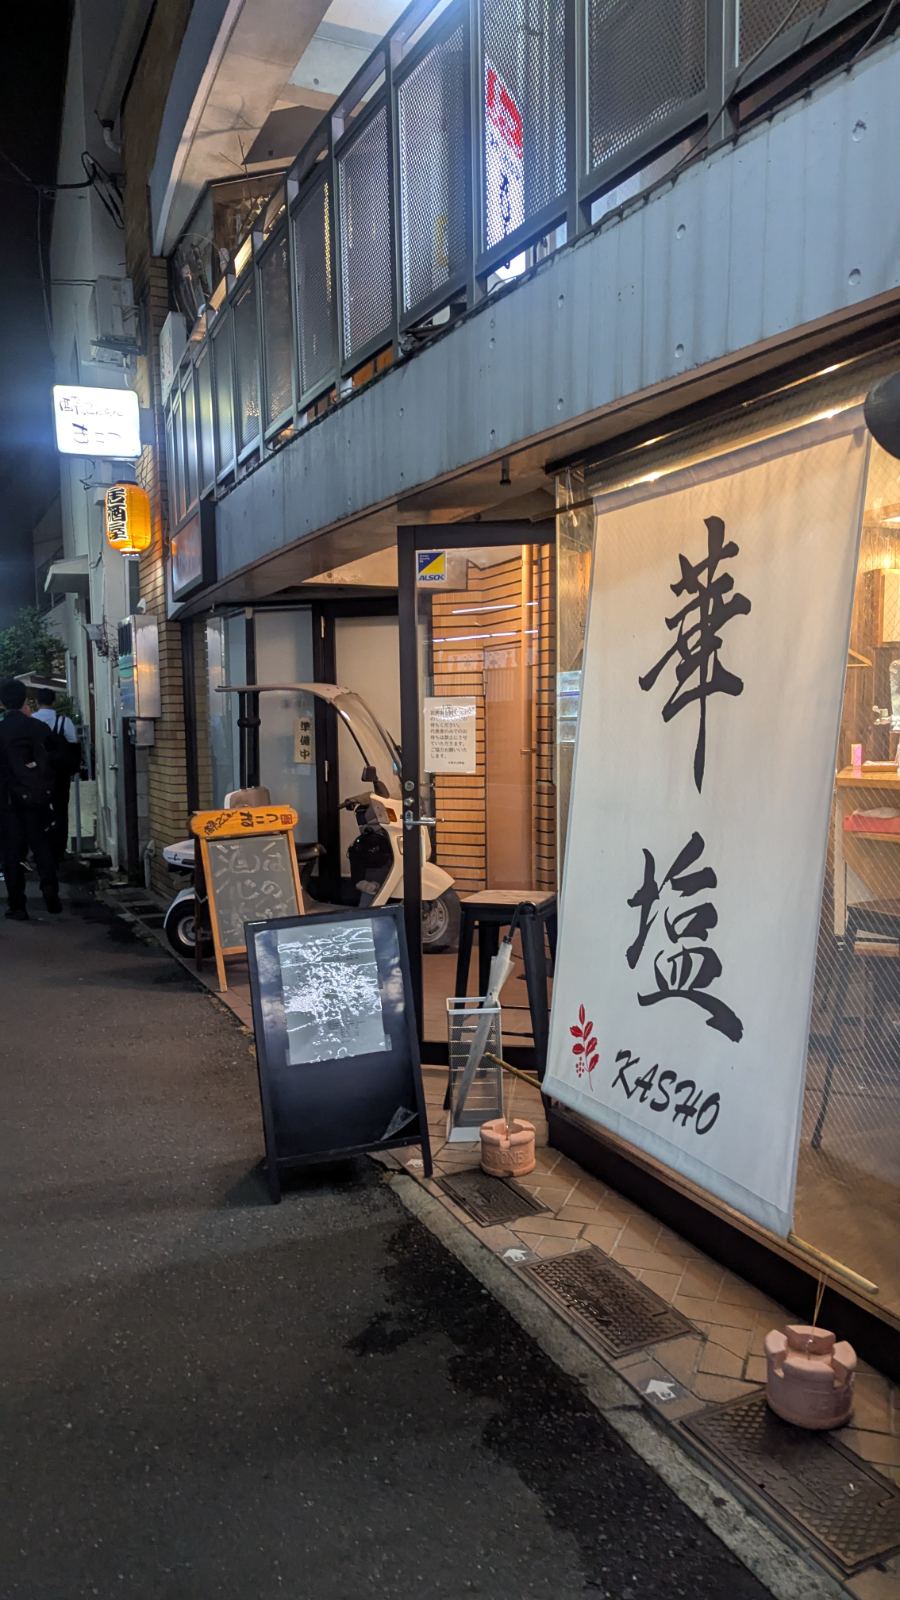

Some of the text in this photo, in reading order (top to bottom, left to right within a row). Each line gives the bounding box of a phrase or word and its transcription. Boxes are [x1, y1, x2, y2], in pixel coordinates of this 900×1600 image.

[107, 487, 127, 540] 居酒屋
[299, 721, 310, 760] 準備中
[627, 515, 752, 1044] 華塩
[612, 1049, 721, 1135] KASHO
